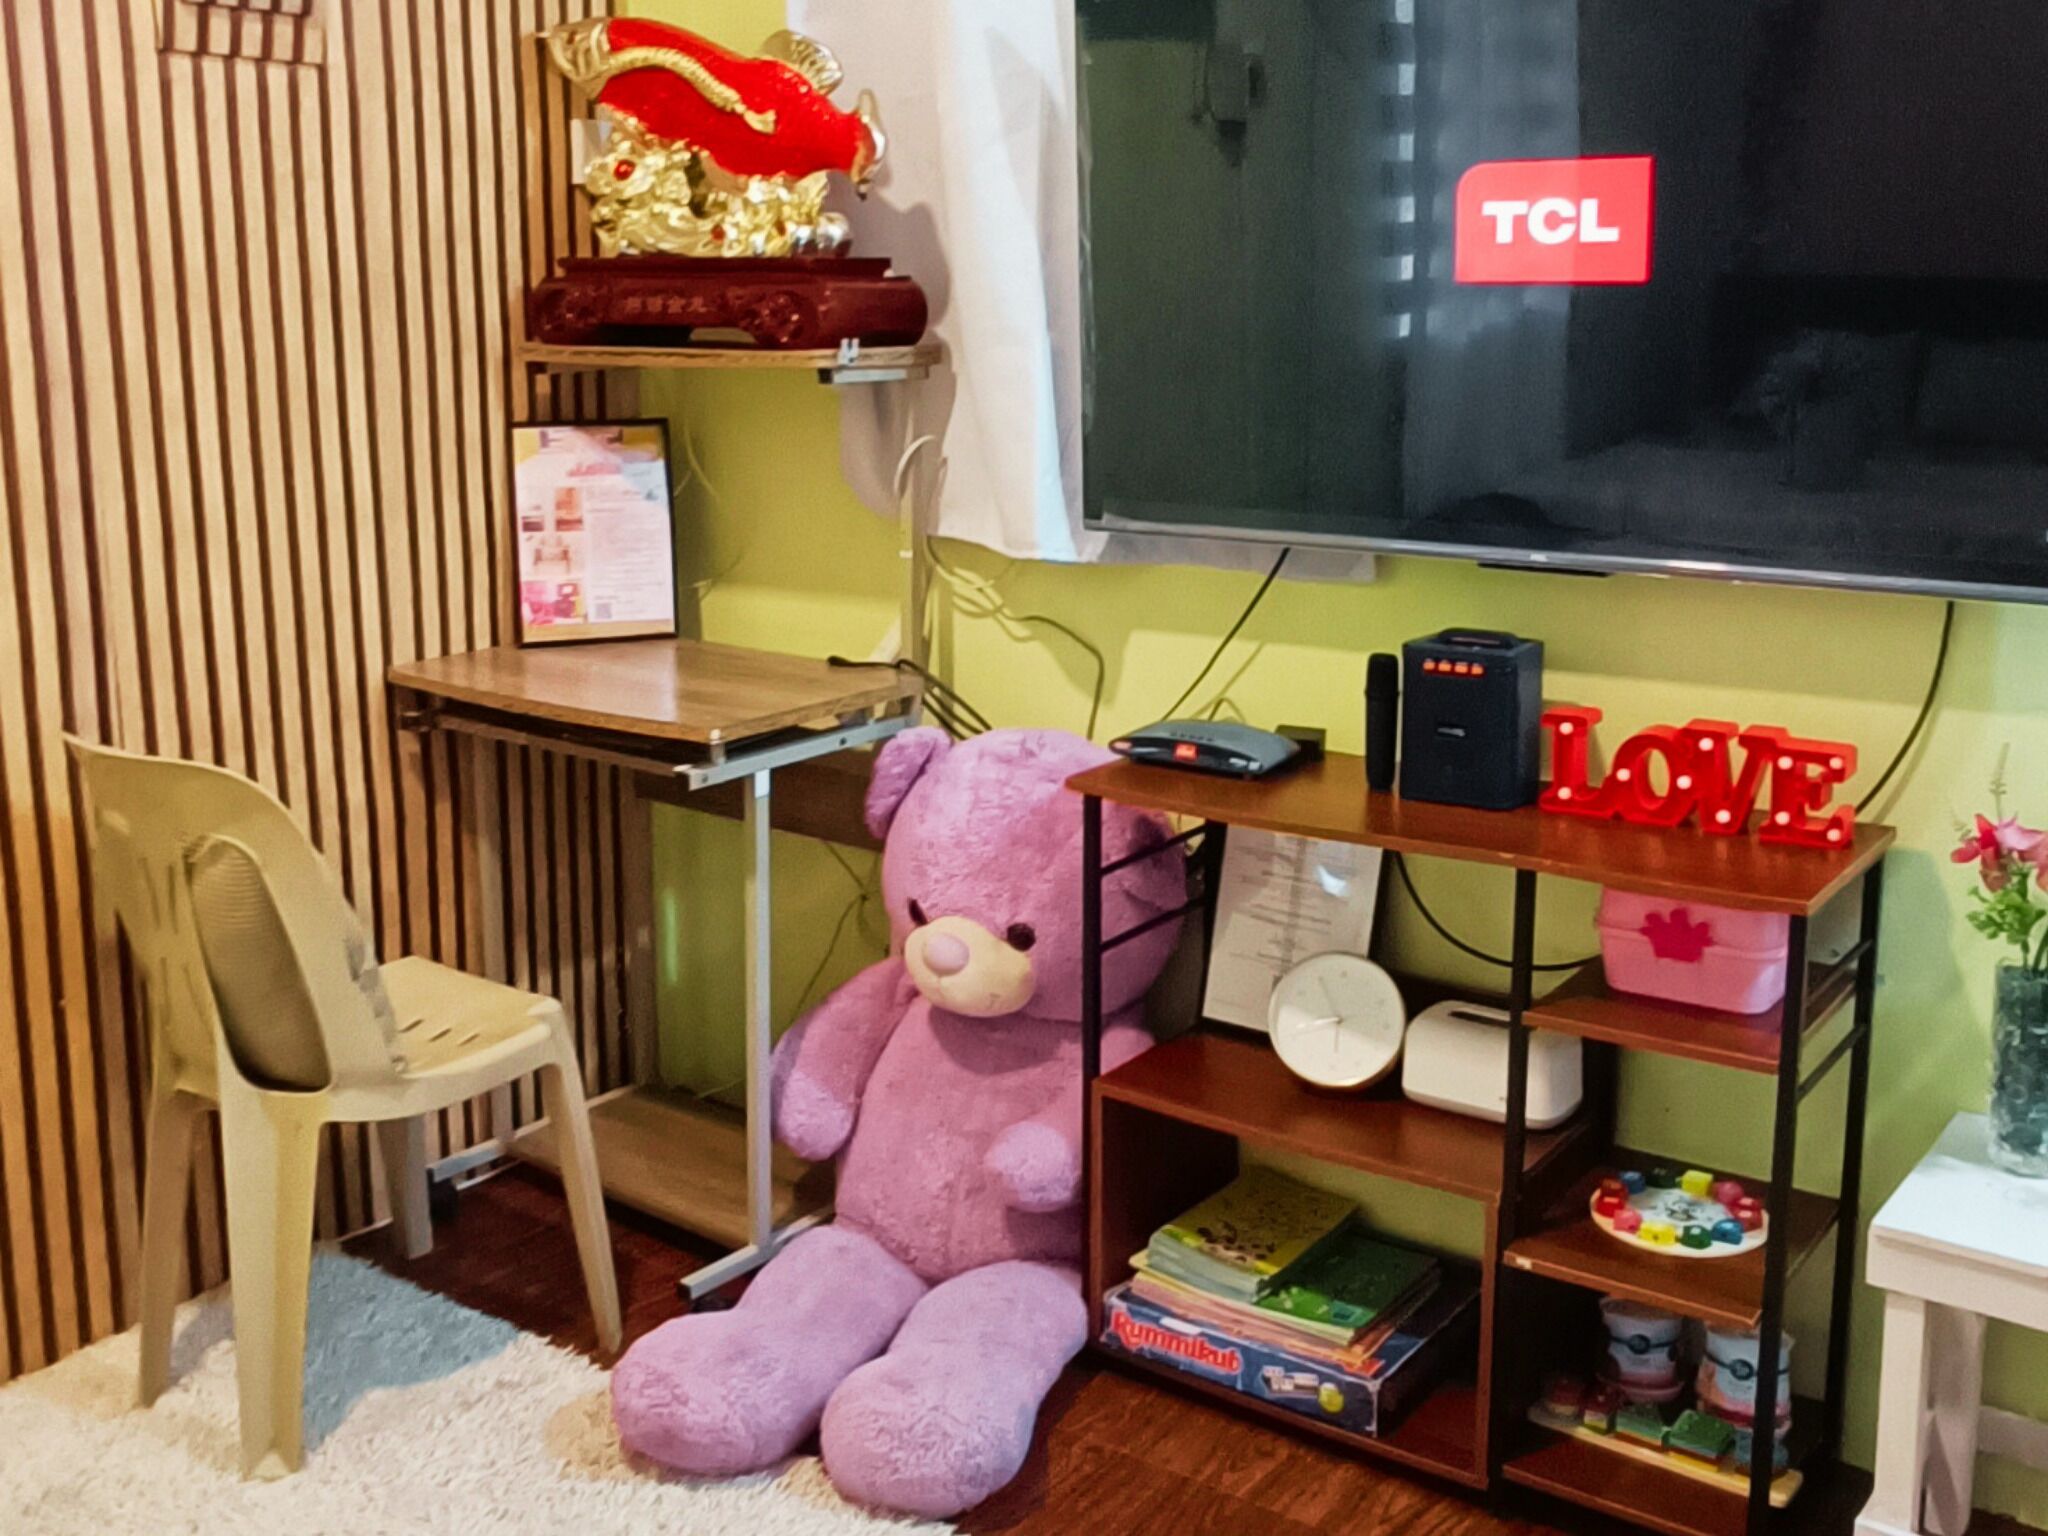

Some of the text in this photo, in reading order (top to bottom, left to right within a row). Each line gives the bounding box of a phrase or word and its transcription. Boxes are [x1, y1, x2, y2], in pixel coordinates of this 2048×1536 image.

[1482, 197, 1620, 245] TCL
[1539, 706, 1857, 849] LOVE
[1111, 1309, 1242, 1375] Rummikub
